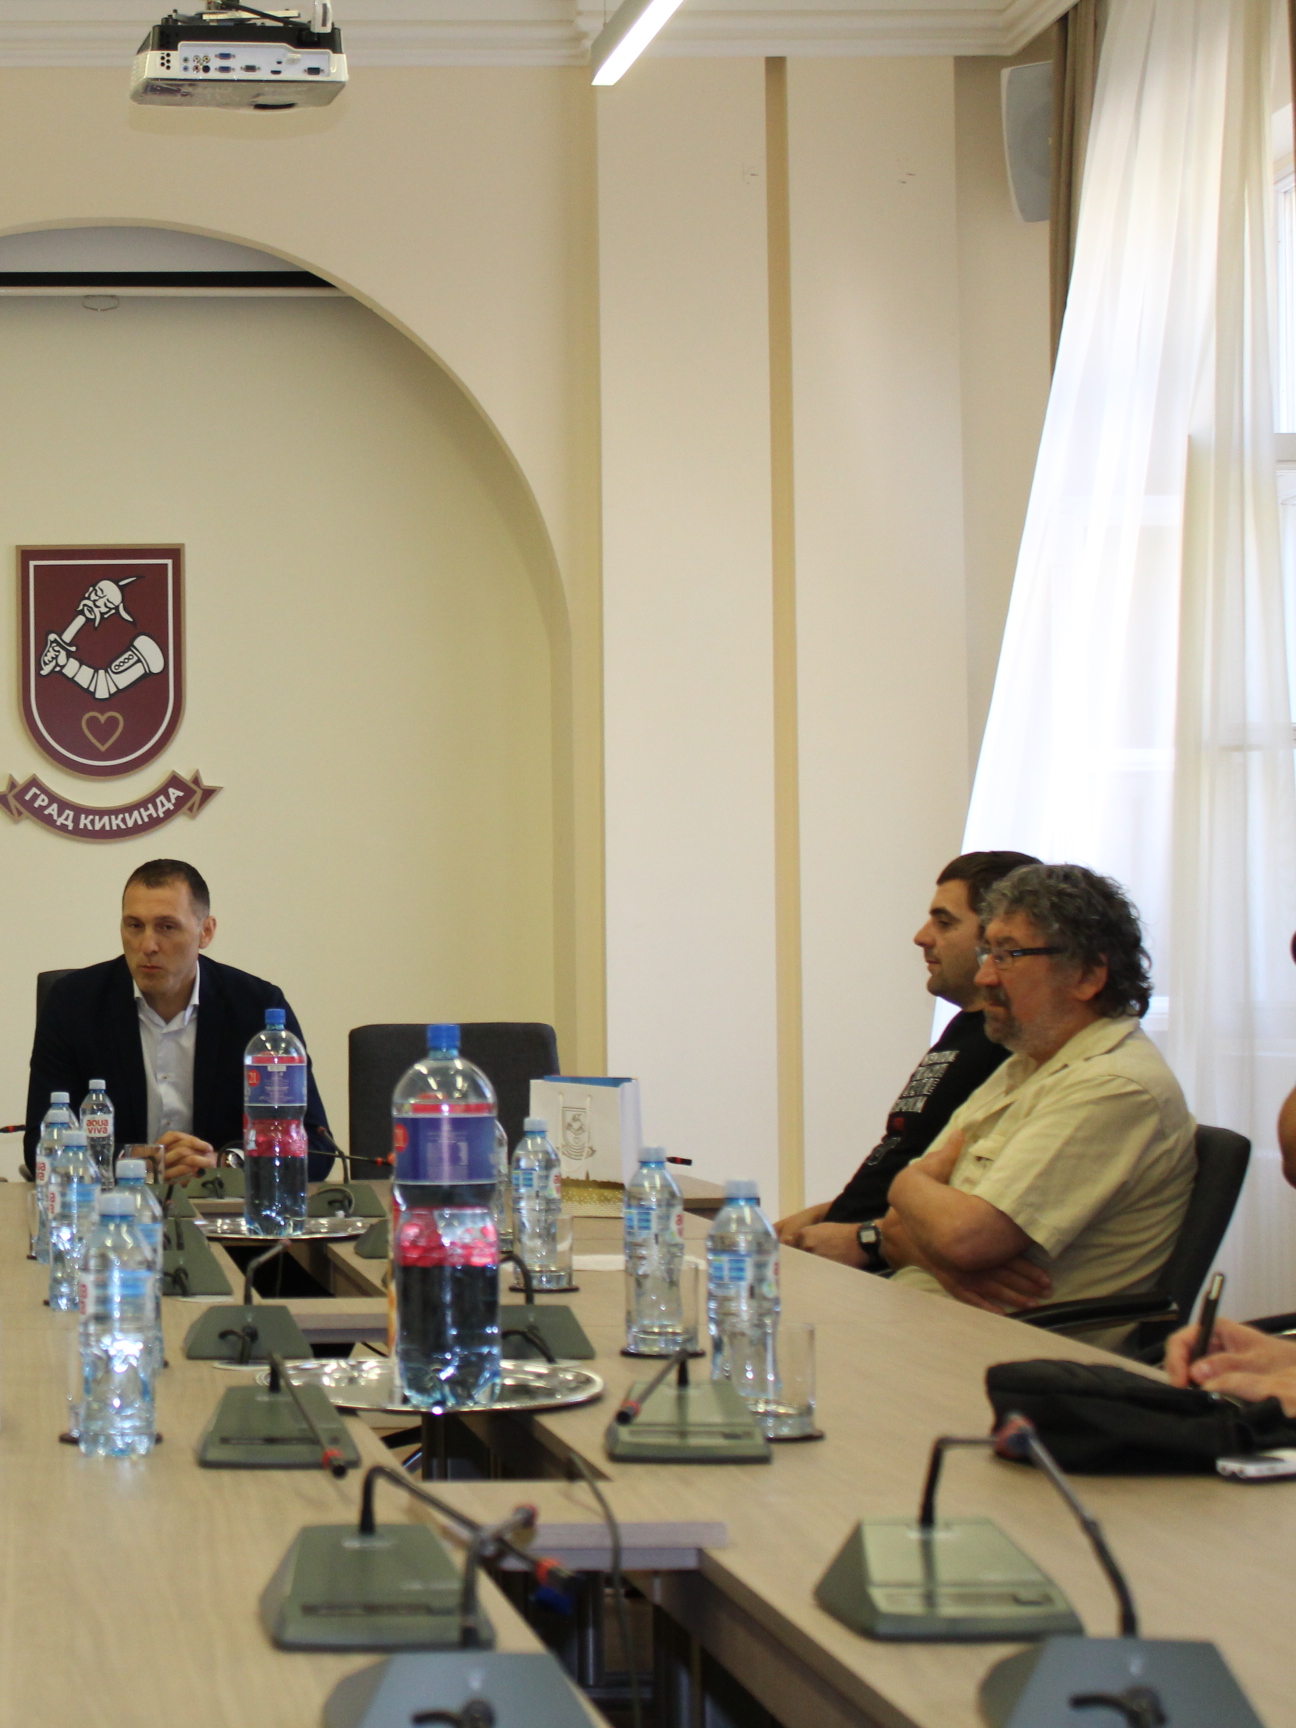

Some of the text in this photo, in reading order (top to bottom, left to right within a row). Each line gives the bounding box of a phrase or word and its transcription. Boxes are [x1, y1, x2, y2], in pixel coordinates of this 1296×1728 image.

[24, 787, 184, 831] ГРАД КИКИНДА
[86, 1119, 109, 1127] aqua
[87, 1126, 108, 1134] viva
